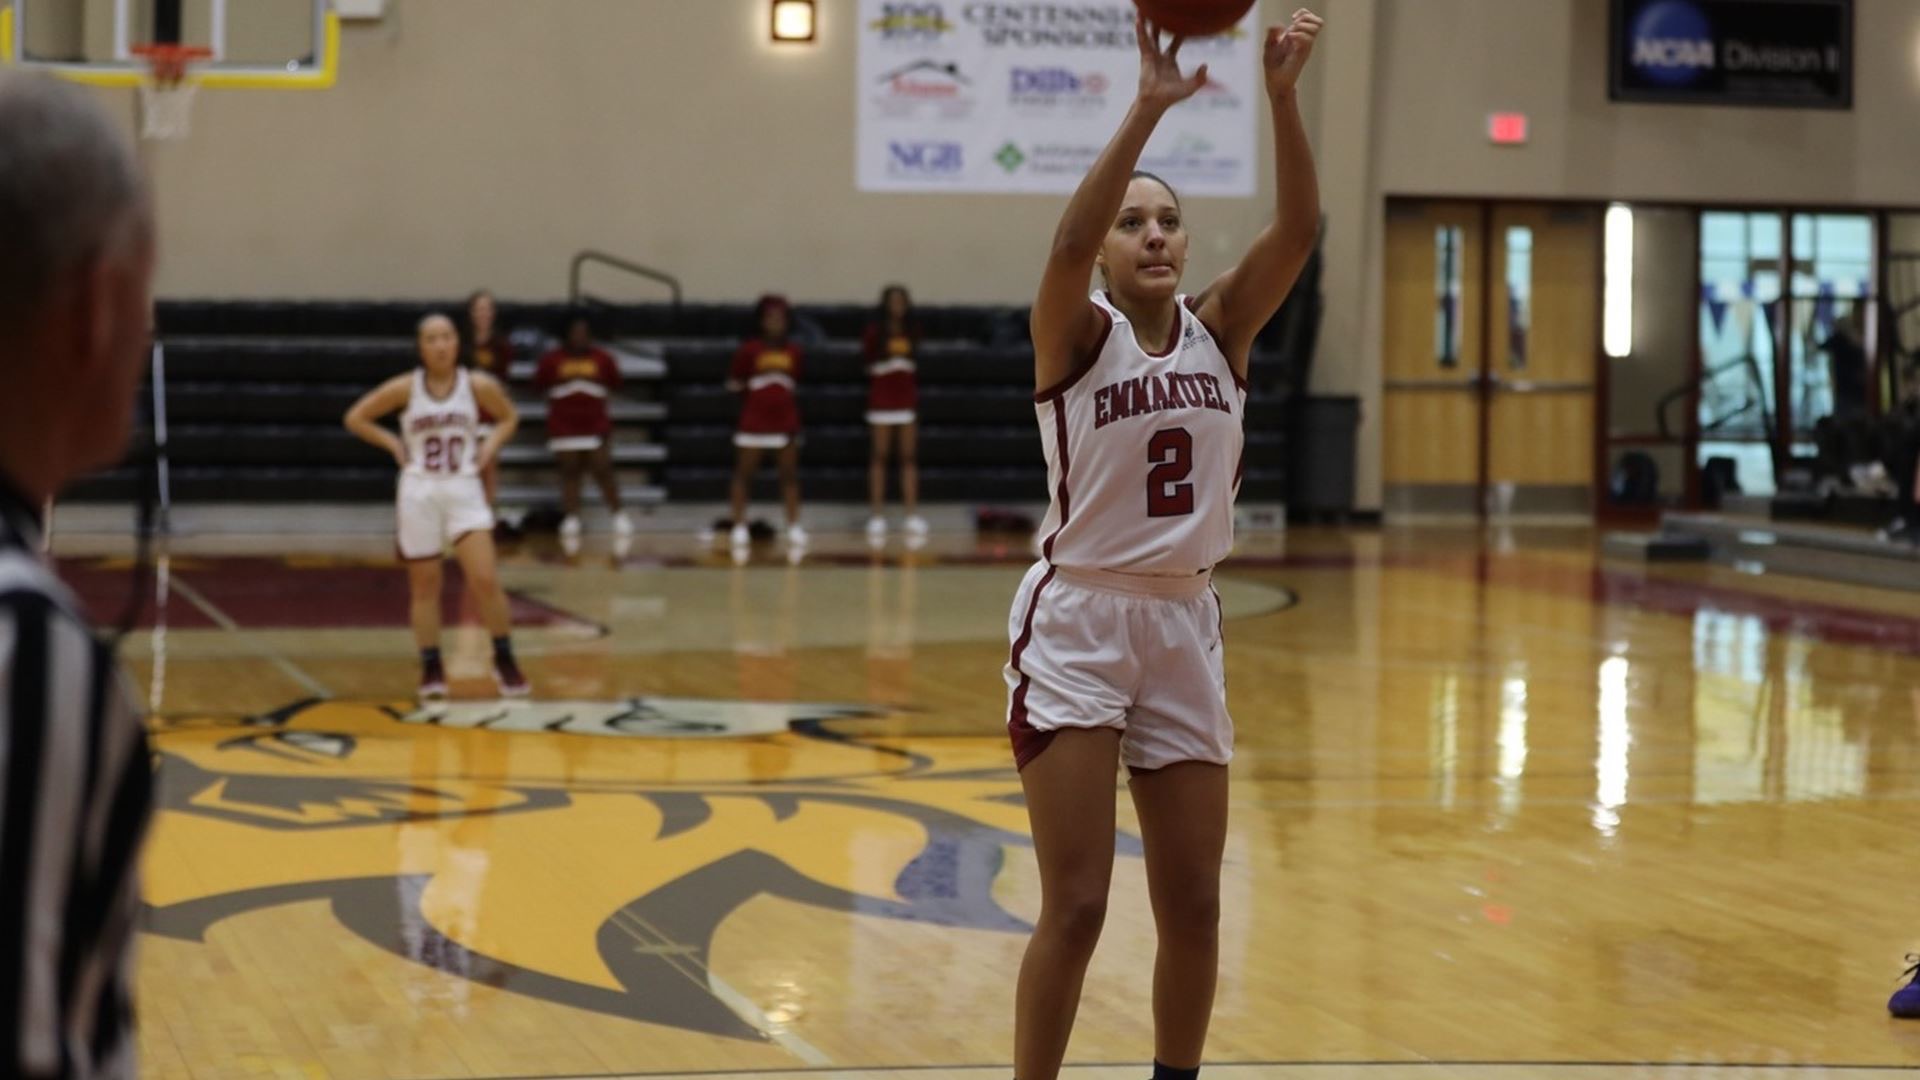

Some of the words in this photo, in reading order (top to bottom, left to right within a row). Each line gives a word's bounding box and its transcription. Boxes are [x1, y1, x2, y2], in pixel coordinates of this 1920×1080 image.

[961, 4, 1138, 25] CENTENNIA
[1631, 38, 1715, 68] NCAA
[1723, 40, 1822, 71] Division
[1094, 371, 1232, 430] EMMANUEL
[1147, 427, 1195, 518] 2
